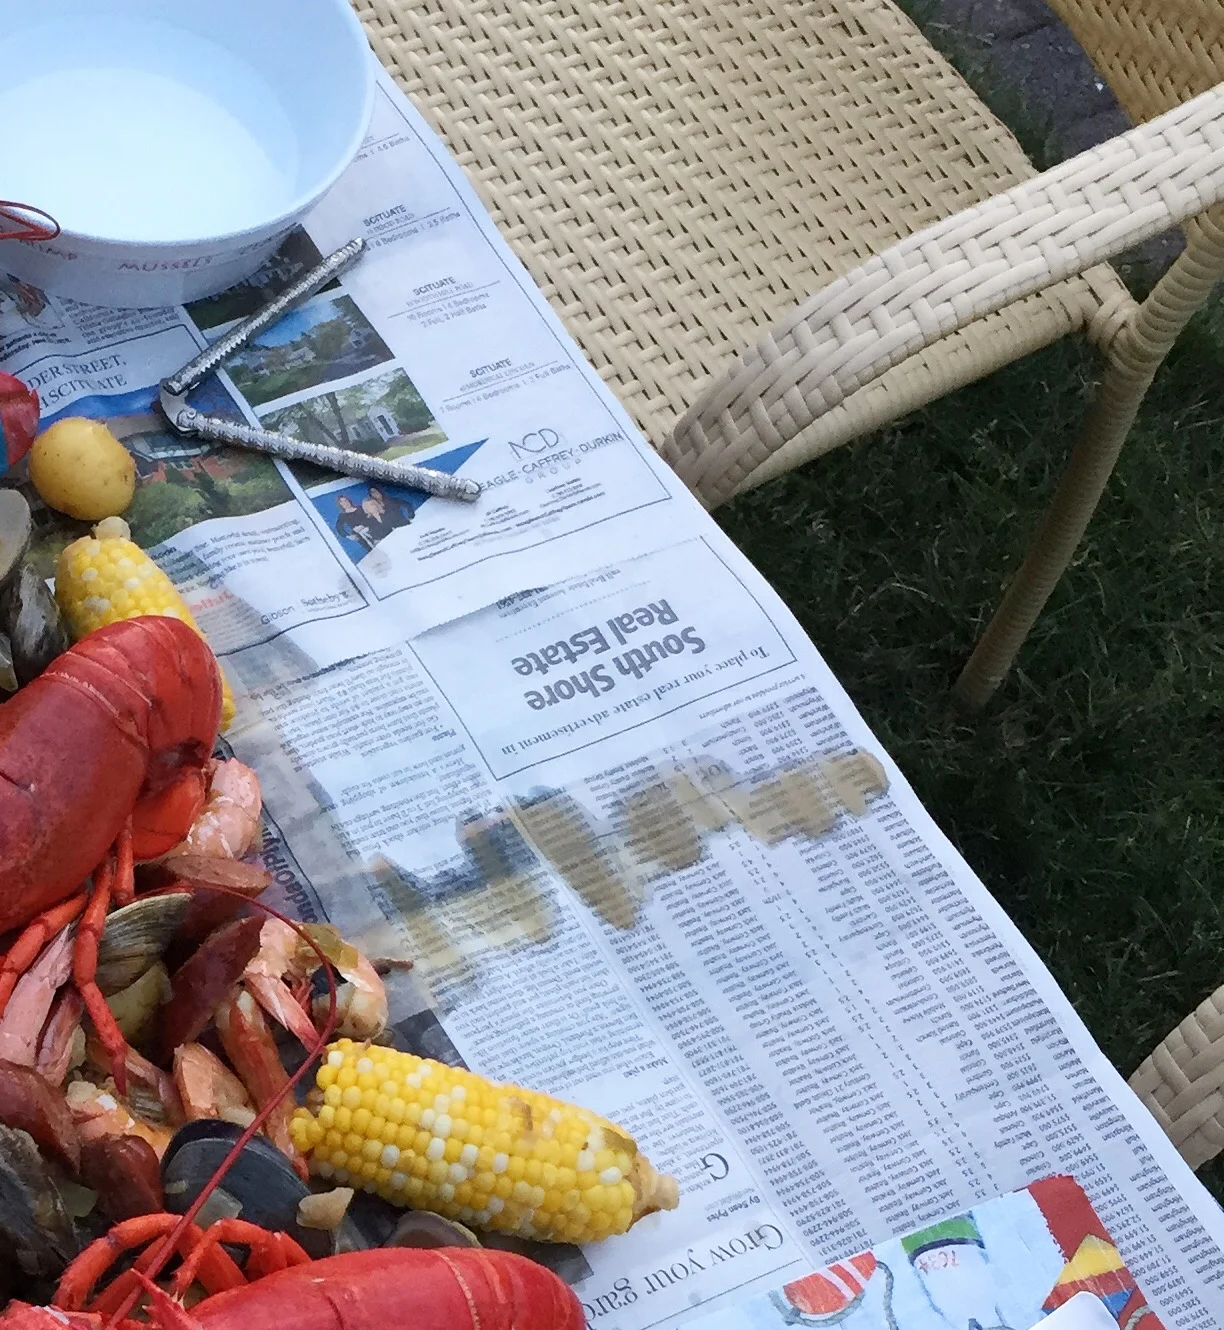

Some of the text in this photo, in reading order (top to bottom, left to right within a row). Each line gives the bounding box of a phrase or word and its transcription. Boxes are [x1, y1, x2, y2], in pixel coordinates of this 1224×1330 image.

[362, 203, 407, 227] SCITUATE
[413, 275, 456, 296] SCITUATE
[469, 357, 512, 378] SCITUATE
[507, 596, 679, 682] Real Estate
[521, 623, 708, 718] South Shore
[500, 644, 769, 758] To place your real estate advertisement in
[637, 1245, 706, 1295] your
[705, 1219, 786, 1274] Grow
